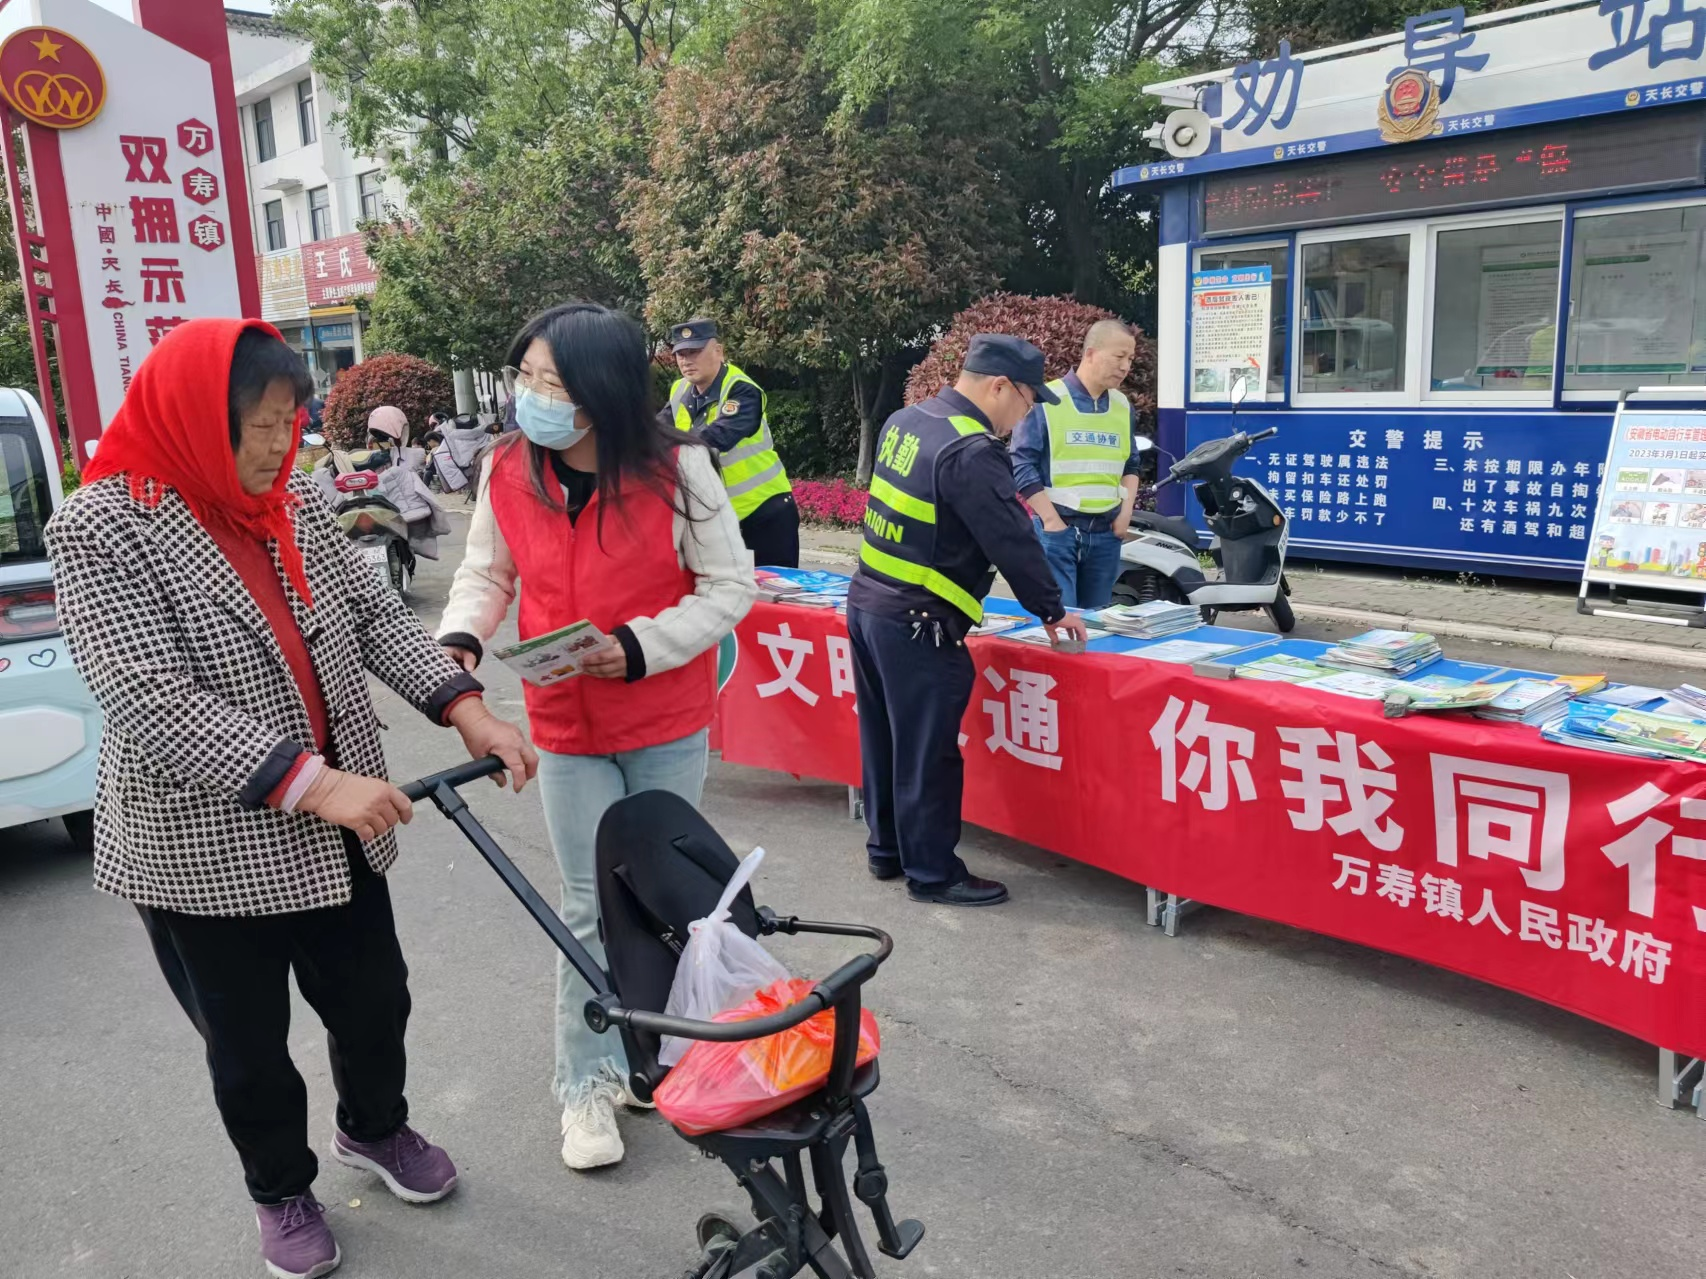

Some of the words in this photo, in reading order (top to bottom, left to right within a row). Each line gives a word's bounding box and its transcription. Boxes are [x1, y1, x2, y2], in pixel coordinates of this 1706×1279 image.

[1645, 81, 1705, 103] 天长交警
[1447, 113, 1496, 132] 天长交警
[1287, 140, 1327, 157] 天长交警
[1151, 163, 1185, 176] 天长交警
[182, 126, 222, 246] 万寿镇
[112, 312, 128, 351] CHINA
[1072, 432, 1117, 446] 交通协管
[1349, 429, 1485, 450] 交警提示
[878, 424, 920, 478] 执勤
[1244, 453, 1389, 469] 一、无证驾驶属违法
[1268, 471, 1388, 489] 拘留扣车还处罚
[1463, 479, 1602, 499] 出了事故自掏
[1268, 488, 1387, 507] 未买保险路上跑
[1432, 497, 1597, 518] 四、十次车祸九次
[755, 622, 1063, 771] 文通
[1331, 853, 1672, 985] 万寿镇人民政府
